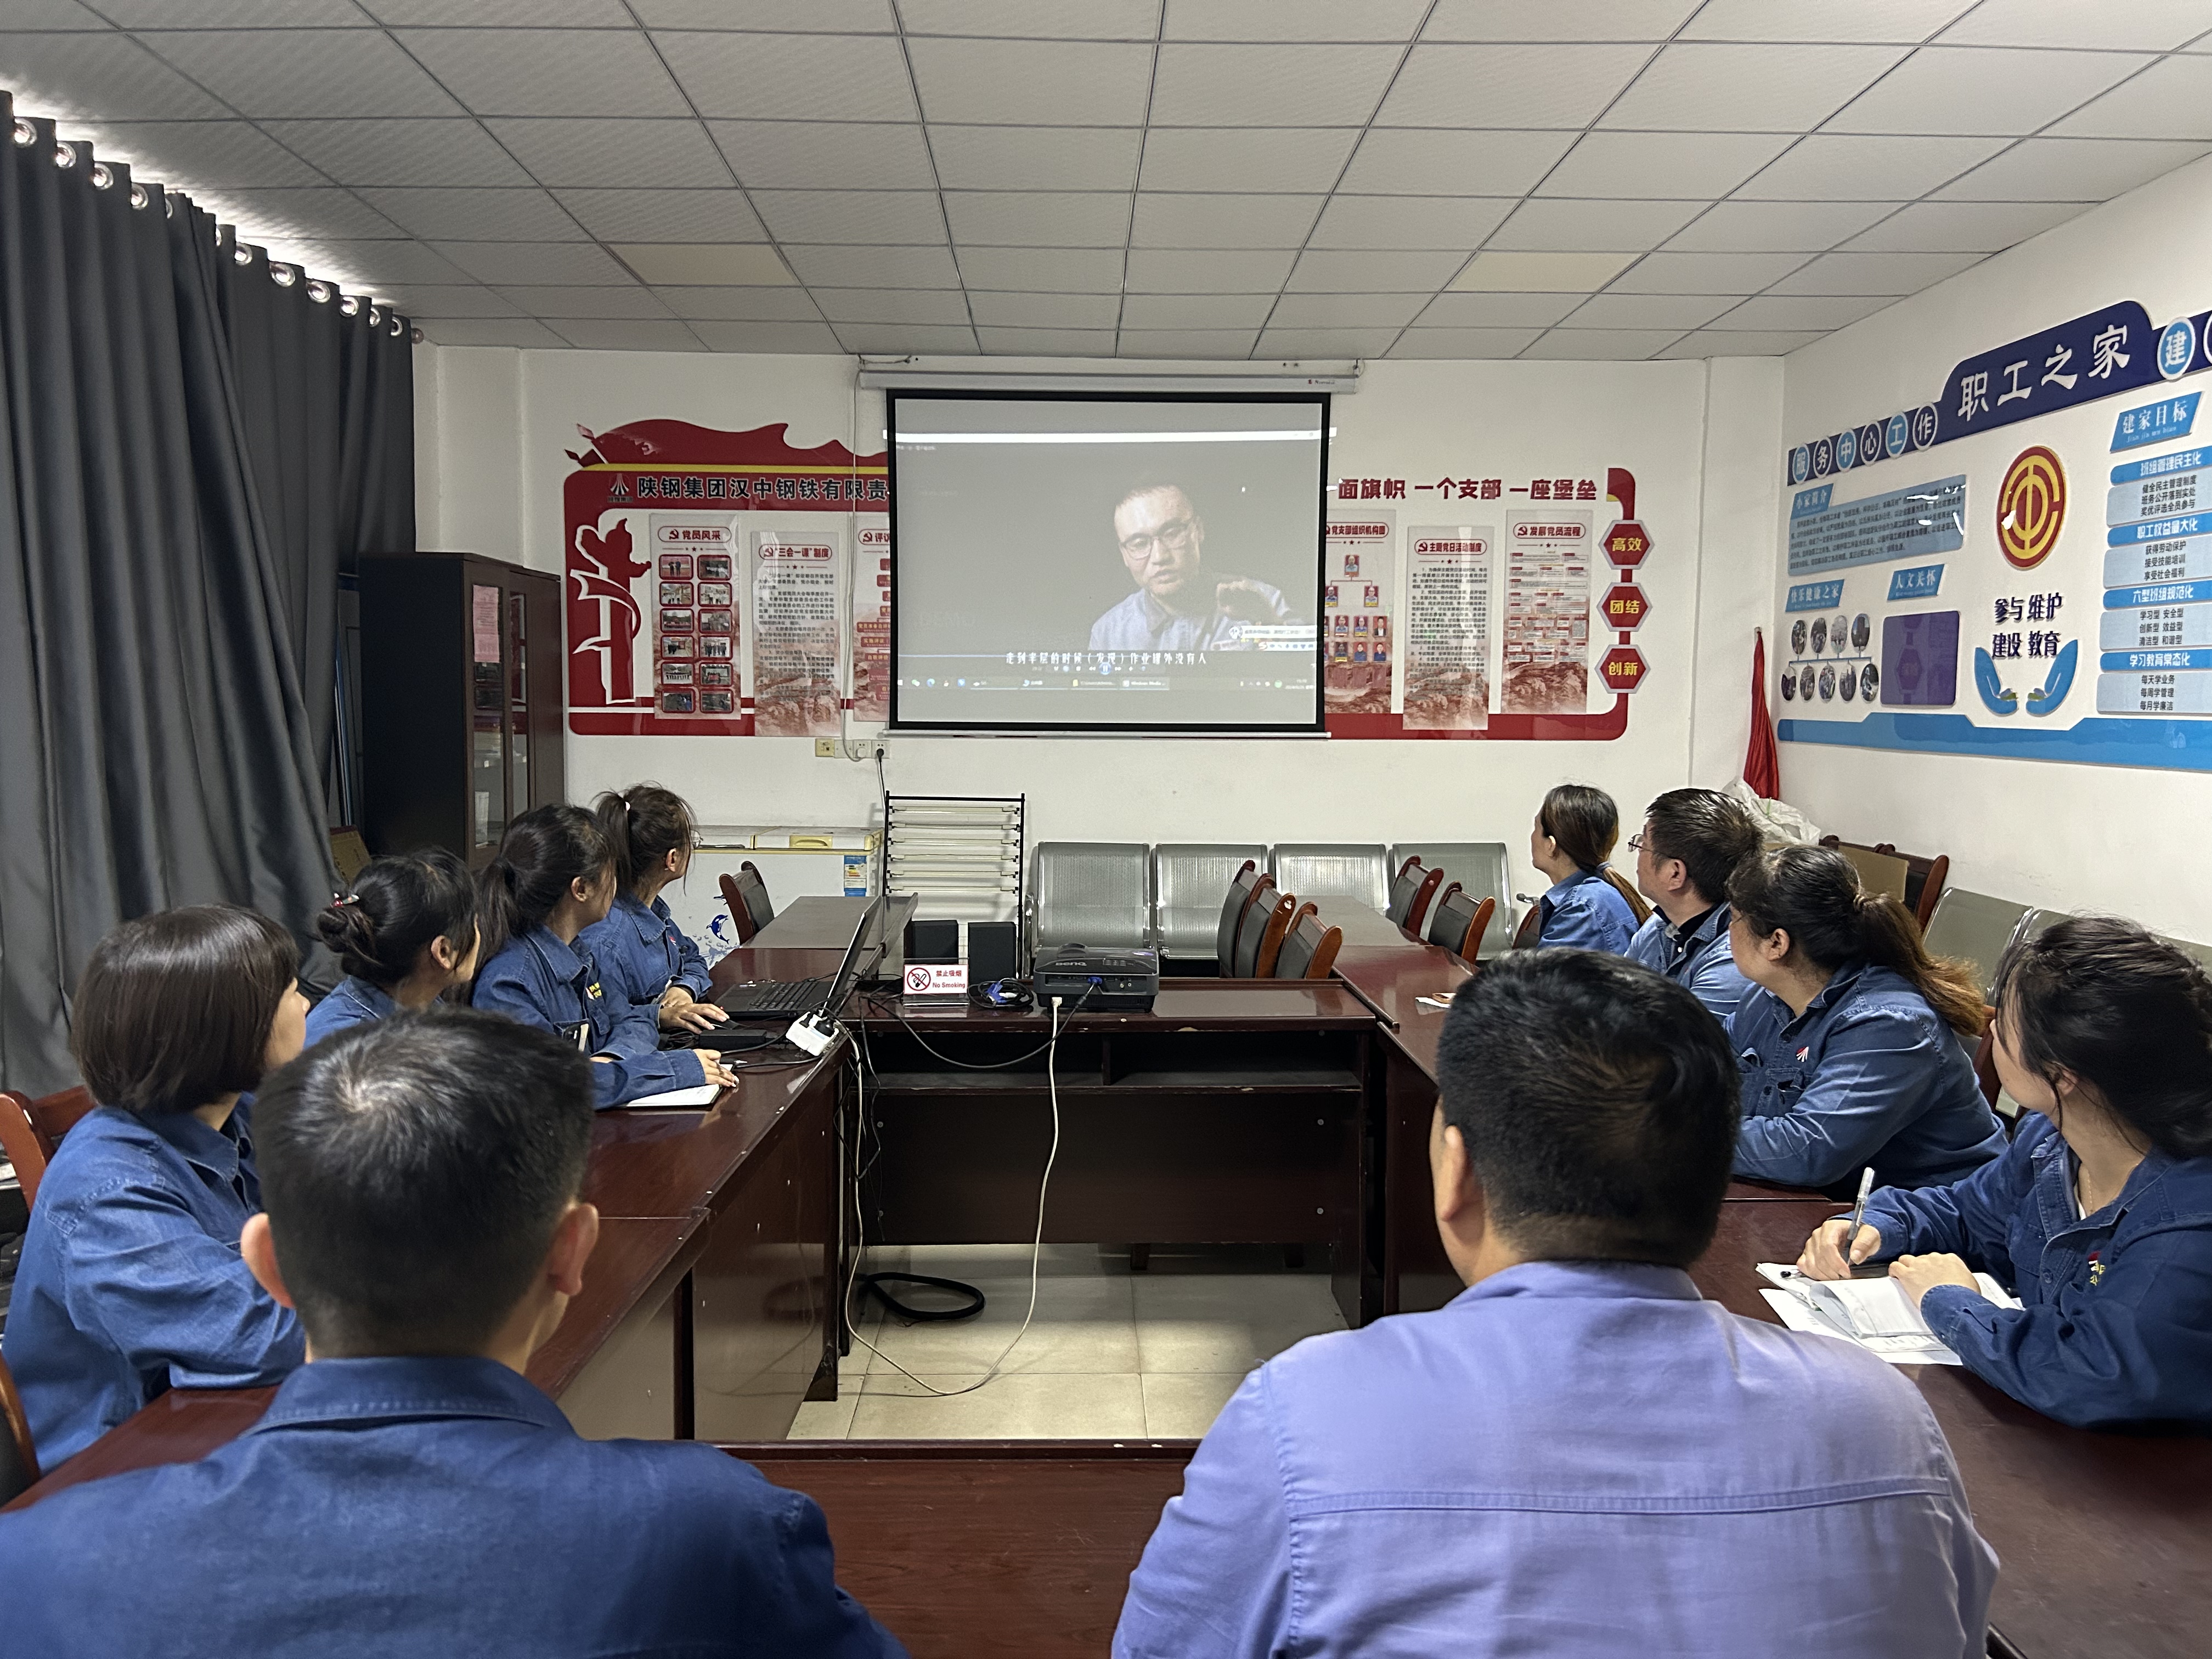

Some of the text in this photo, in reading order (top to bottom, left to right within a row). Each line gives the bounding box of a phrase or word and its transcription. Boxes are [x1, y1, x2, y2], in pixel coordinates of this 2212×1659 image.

[2165, 330, 2187, 367] 建
[1957, 325, 2130, 421] 职工之家
[2123, 400, 2188, 435] 建家目标
[1796, 413, 1933, 476] 服务中心工作
[2140, 451, 2202, 477] 班组管理民主化
[637, 476, 887, 500] 陕钢集团汉中钢铁有限责
[1327, 477, 1597, 500] 面旗帜 一个支部 一座堡垒
[2142, 475, 2197, 494] 健全民主管理制度
[2141, 488, 2196, 505] 班务公开落到实处
[2141, 499, 2196, 516] 奖优评选全员参与
[682, 530, 720, 540] 党员风采
[1331, 525, 1385, 535] 党支部组织机构图
[1530, 526, 1581, 537] 发展党员流程
[2137, 517, 2198, 539] 职工权益最大化
[1612, 537, 1642, 552] 高效
[2146, 540, 2186, 555] 获得劳动保护
[2145, 554, 2186, 568] 接受技能培训
[2144, 567, 2185, 581] 享受社会福利
[2132, 584, 2194, 603] 六型班组规范化
[1610, 600, 1640, 614] 团结
[1994, 592, 2063, 623] 参与 维护
[2140, 608, 2184, 620] 学习型 安全型
[2140, 621, 2183, 633] 创新型 效益型
[1992, 630, 2061, 658] 建设 教育
[2139, 635, 2182, 646] 清洁型 和谐型
[2130, 652, 2191, 667] 学习教育常态化
[1609, 661, 1638, 676] 创新
[2141, 675, 2175, 685] 每天学业务
[2141, 688, 2174, 698] 每周学管理
[2140, 701, 2174, 711] 每月学廉洁
